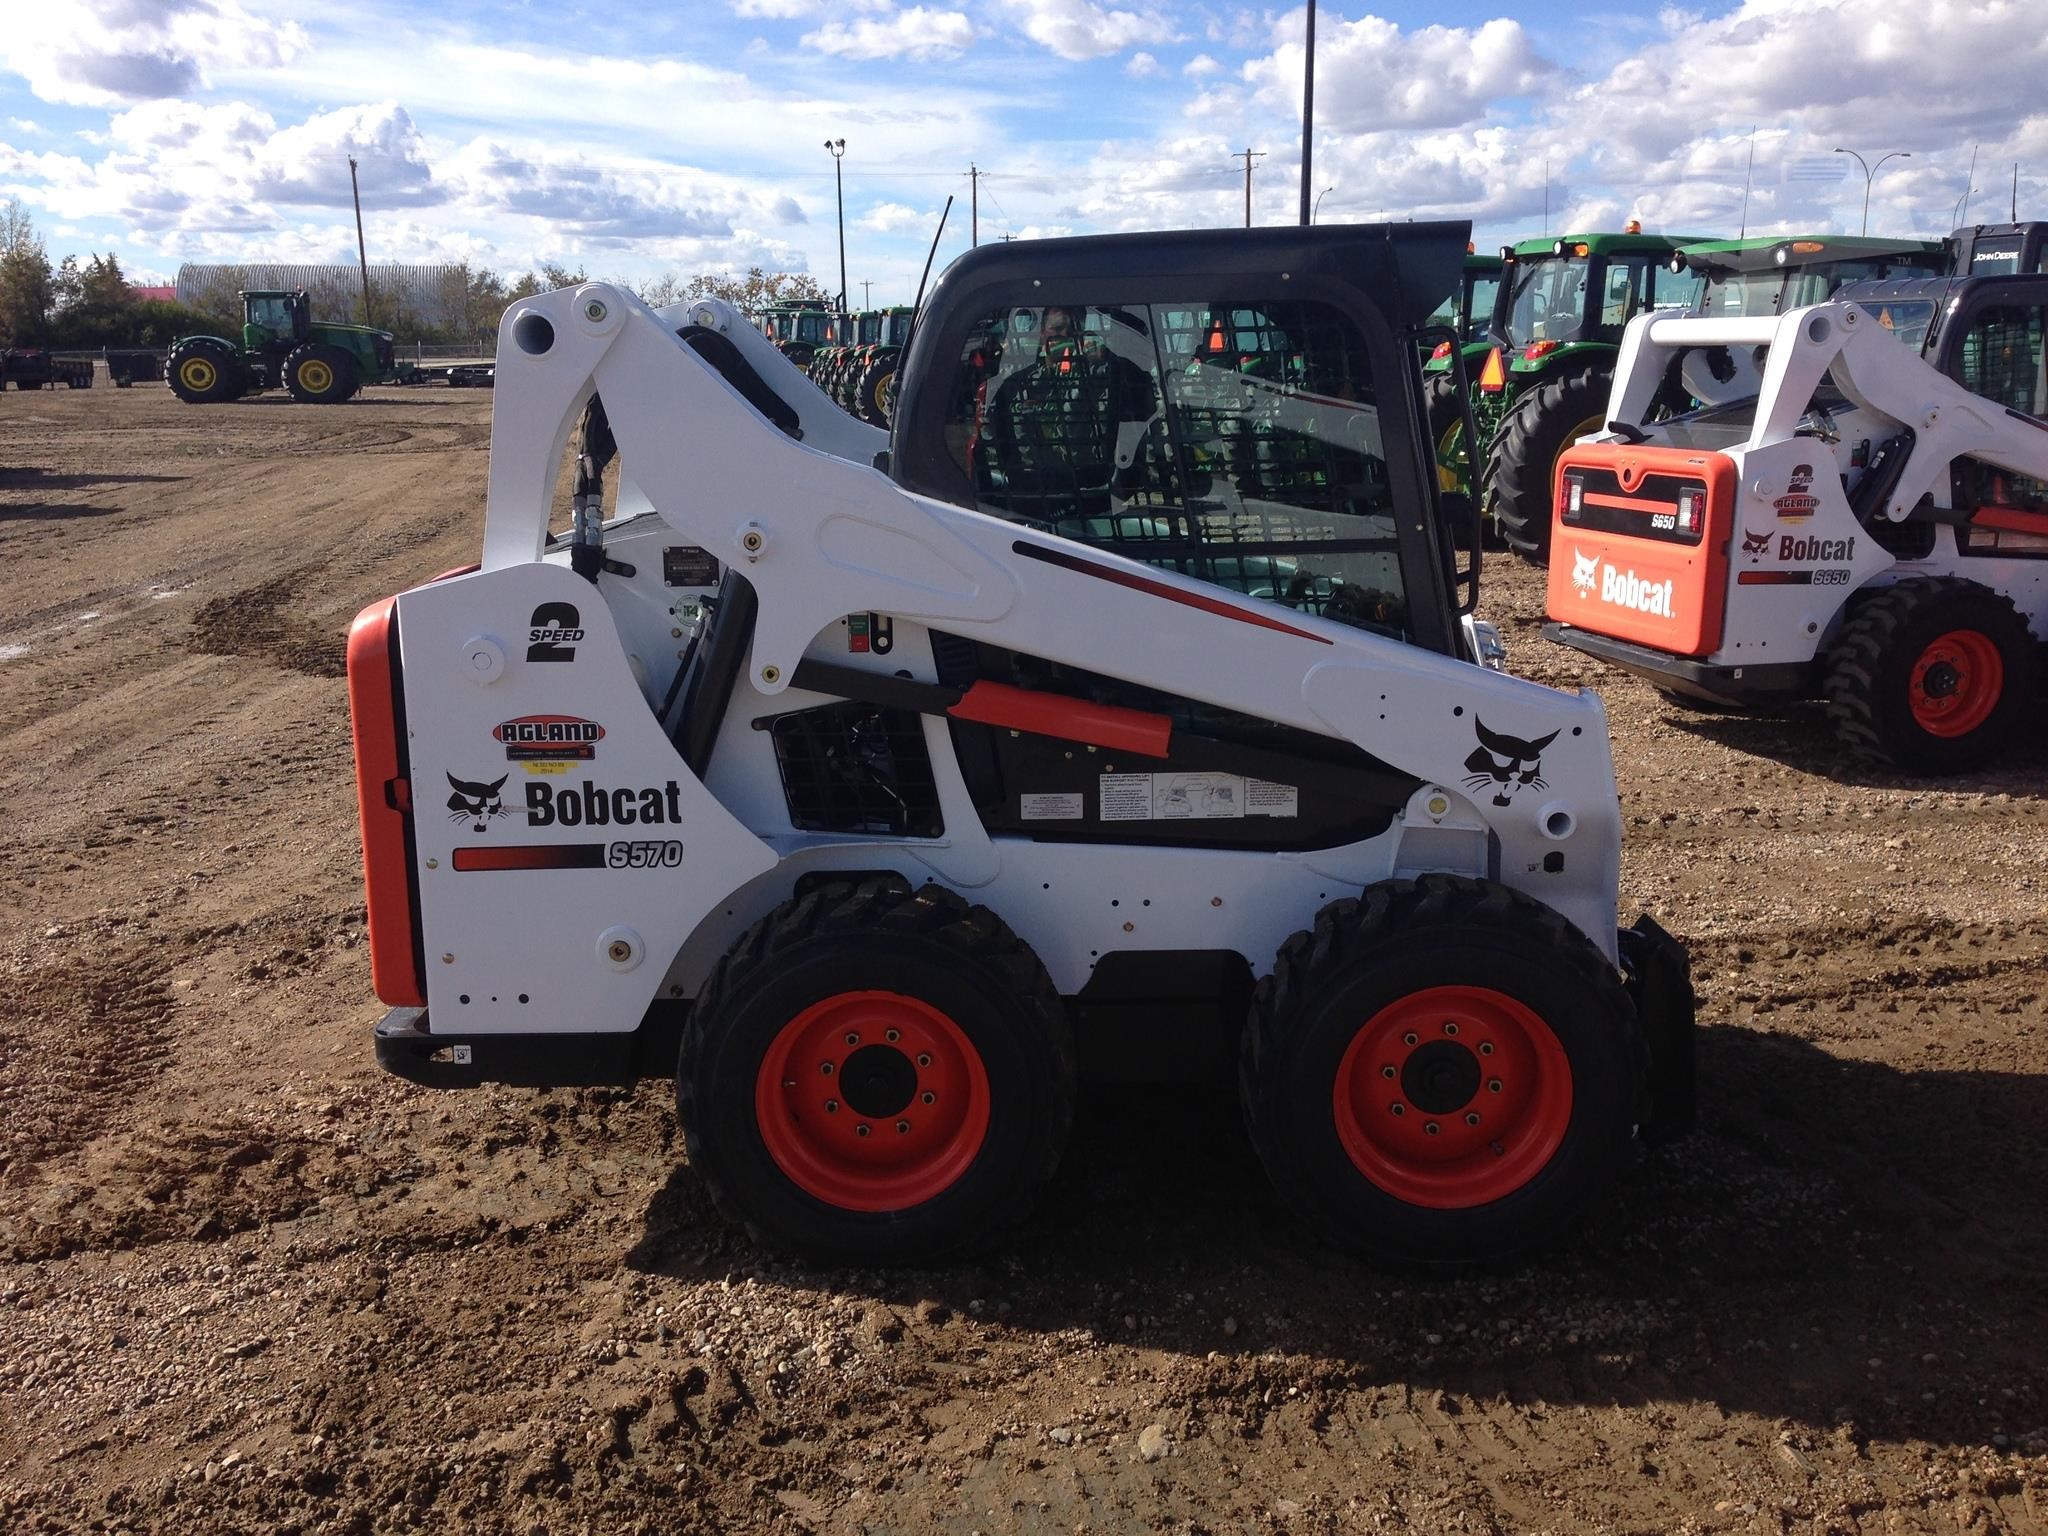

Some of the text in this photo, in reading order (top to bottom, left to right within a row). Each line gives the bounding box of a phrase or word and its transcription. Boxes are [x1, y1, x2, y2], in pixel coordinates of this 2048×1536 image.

[1974, 253, 1995, 262] JOHN
[1787, 464, 1814, 493] 2
[1777, 498, 1818, 508] AGLAND
[1651, 514, 1676, 530] S650
[1779, 535, 1855, 561] Bobcat
[1813, 569, 1851, 586] S650
[1602, 563, 1674, 618] Bobcat
[526, 602, 580, 662] 2
[529, 629, 585, 642] SPEED
[501, 723, 598, 741] AGLAND
[525, 780, 682, 827] Bobcat
[609, 839, 683, 869] S570
